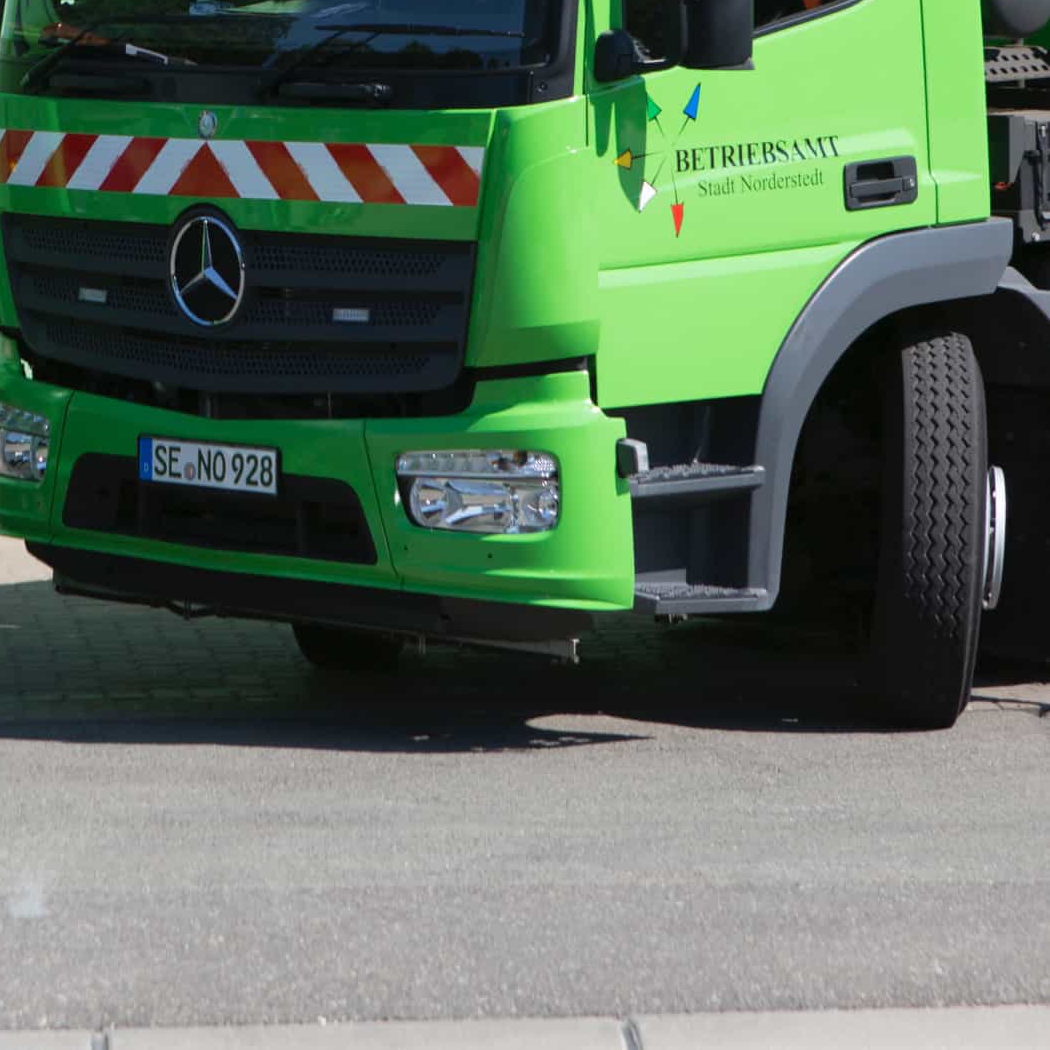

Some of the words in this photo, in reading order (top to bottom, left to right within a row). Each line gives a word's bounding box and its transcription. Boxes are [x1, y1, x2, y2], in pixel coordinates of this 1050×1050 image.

[676, 135, 839, 173] BETRIEBSAMT
[697, 176, 736, 198] Stadt
[741, 168, 824, 193] Norderstedt
[154, 444, 182, 479] SE
[197, 447, 227, 483] NO
[231, 452, 274, 487] 928
